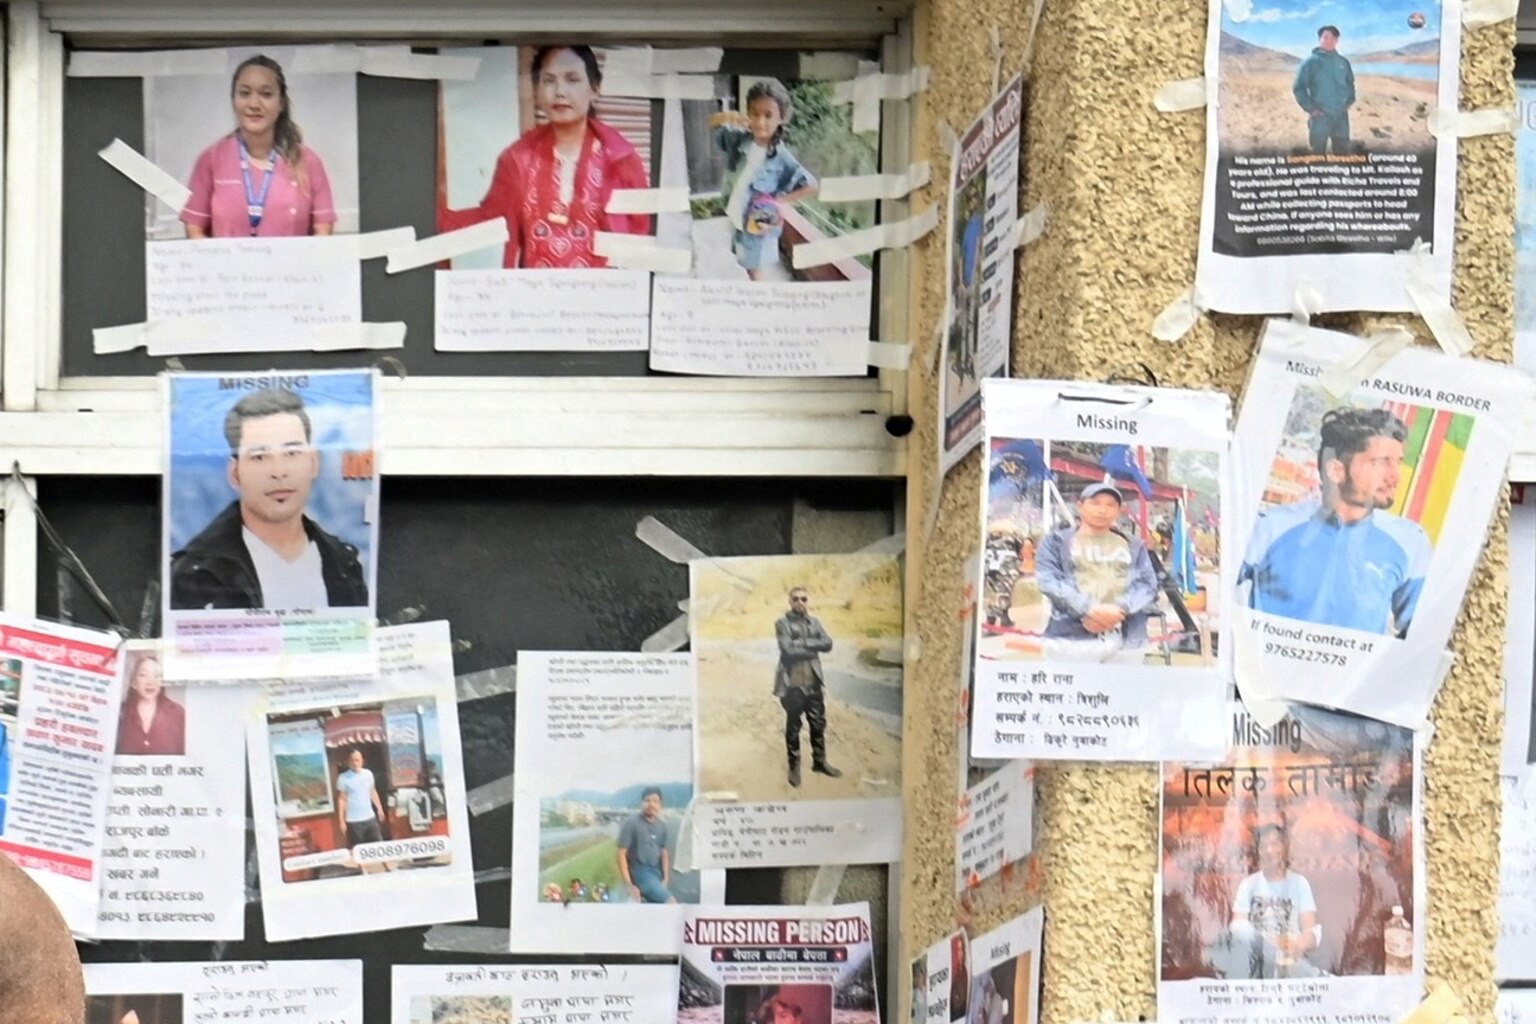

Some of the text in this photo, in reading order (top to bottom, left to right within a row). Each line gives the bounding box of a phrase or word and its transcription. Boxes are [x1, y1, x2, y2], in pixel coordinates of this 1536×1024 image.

[1278, 156, 1285, 164] is
[1368, 153, 1404, 163] (around
[1229, 168, 1252, 177] years
[1311, 166, 1349, 176] traveling
[1237, 179, 1292, 188] professional
[1294, 177, 1320, 187] guide
[1322, 177, 1340, 185] with
[1369, 177, 1401, 185] Travels
[1260, 190, 1278, 198] and
[1319, 189, 1363, 197] contacted
[1240, 202, 1255, 210] AM
[1257, 201, 1280, 209] while
[1282, 200, 1327, 209] collecting
[1329, 201, 1371, 209] passports
[1228, 213, 1258, 221] toward
[1299, 212, 1332, 220] anyone
[1403, 212, 1420, 221] any
[1235, 224, 1288, 233] information
[1290, 223, 1334, 233] regarding
[1351, 223, 1411, 231] whereabouts.
[218, 375, 310, 390] MISSING
[1372, 378, 1491, 411] RASUWA BORDER
[1077, 414, 1138, 435] Missing
[1251, 619, 1374, 652] If found contact at
[1264, 642, 1347, 667] 9765227578
[998, 672, 1017, 684] नाम
[1233, 712, 1302, 753] Missing
[1183, 767, 1268, 801] तिलक
[359, 839, 446, 860] 9808976098
[699, 919, 860, 944] MISSING PERSON
